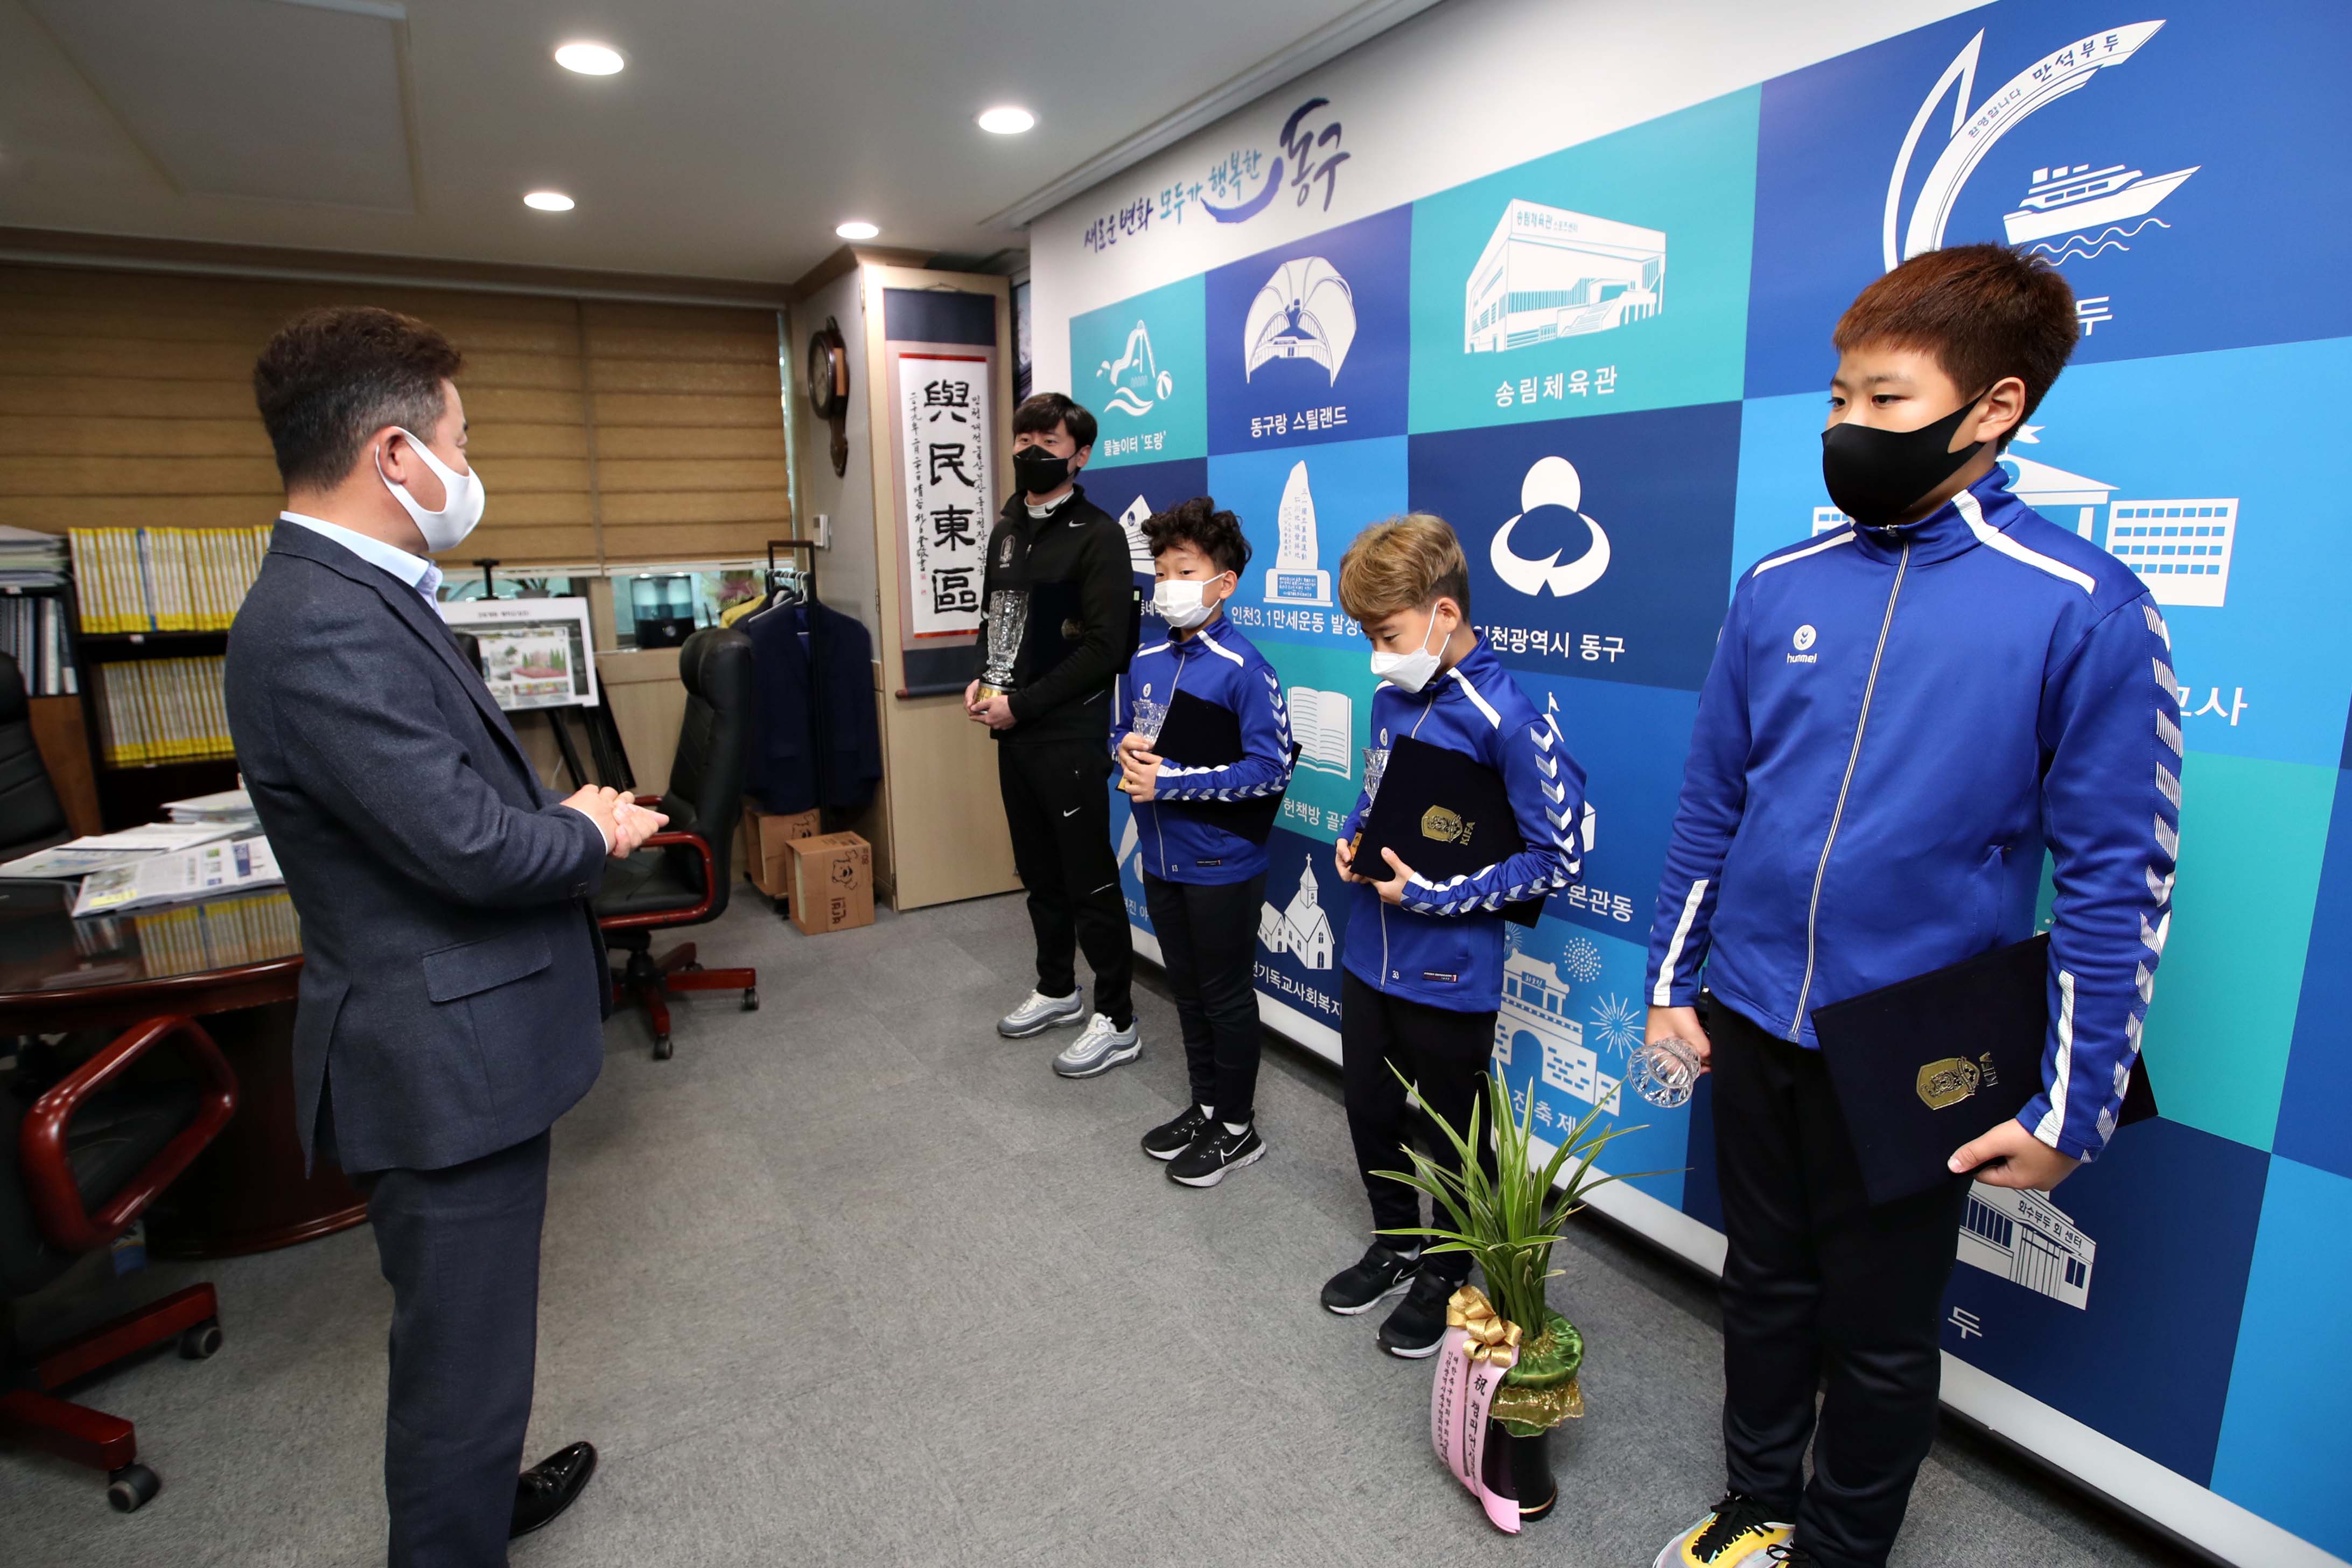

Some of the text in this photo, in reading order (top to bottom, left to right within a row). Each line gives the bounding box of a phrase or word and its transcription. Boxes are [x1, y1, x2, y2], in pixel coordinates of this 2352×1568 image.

[1968, 34, 2119, 138] 환영합니다 만석부두
[1084, 97, 1351, 253] 새로운 변화 모두가 행복한 동구
[1495, 365, 1618, 408] 송림체육관
[1250, 405, 1348, 438] 동구랑 스틸랜드
[1104, 439, 1138, 457] 물놀이터
[1231, 606, 1363, 636] 인천3.1만세운동 발상
[1580, 634, 1625, 663] 동구
[1787, 653, 1817, 663] hummel
[1283, 797, 1321, 825] 헌책방
[1567, 885, 1634, 922] 본관동
[2018, 1200, 2082, 1249] 화수부두 회 센터
[1947, 1305, 1983, 1340] 두
[1474, 1373, 1488, 1396] 祝
